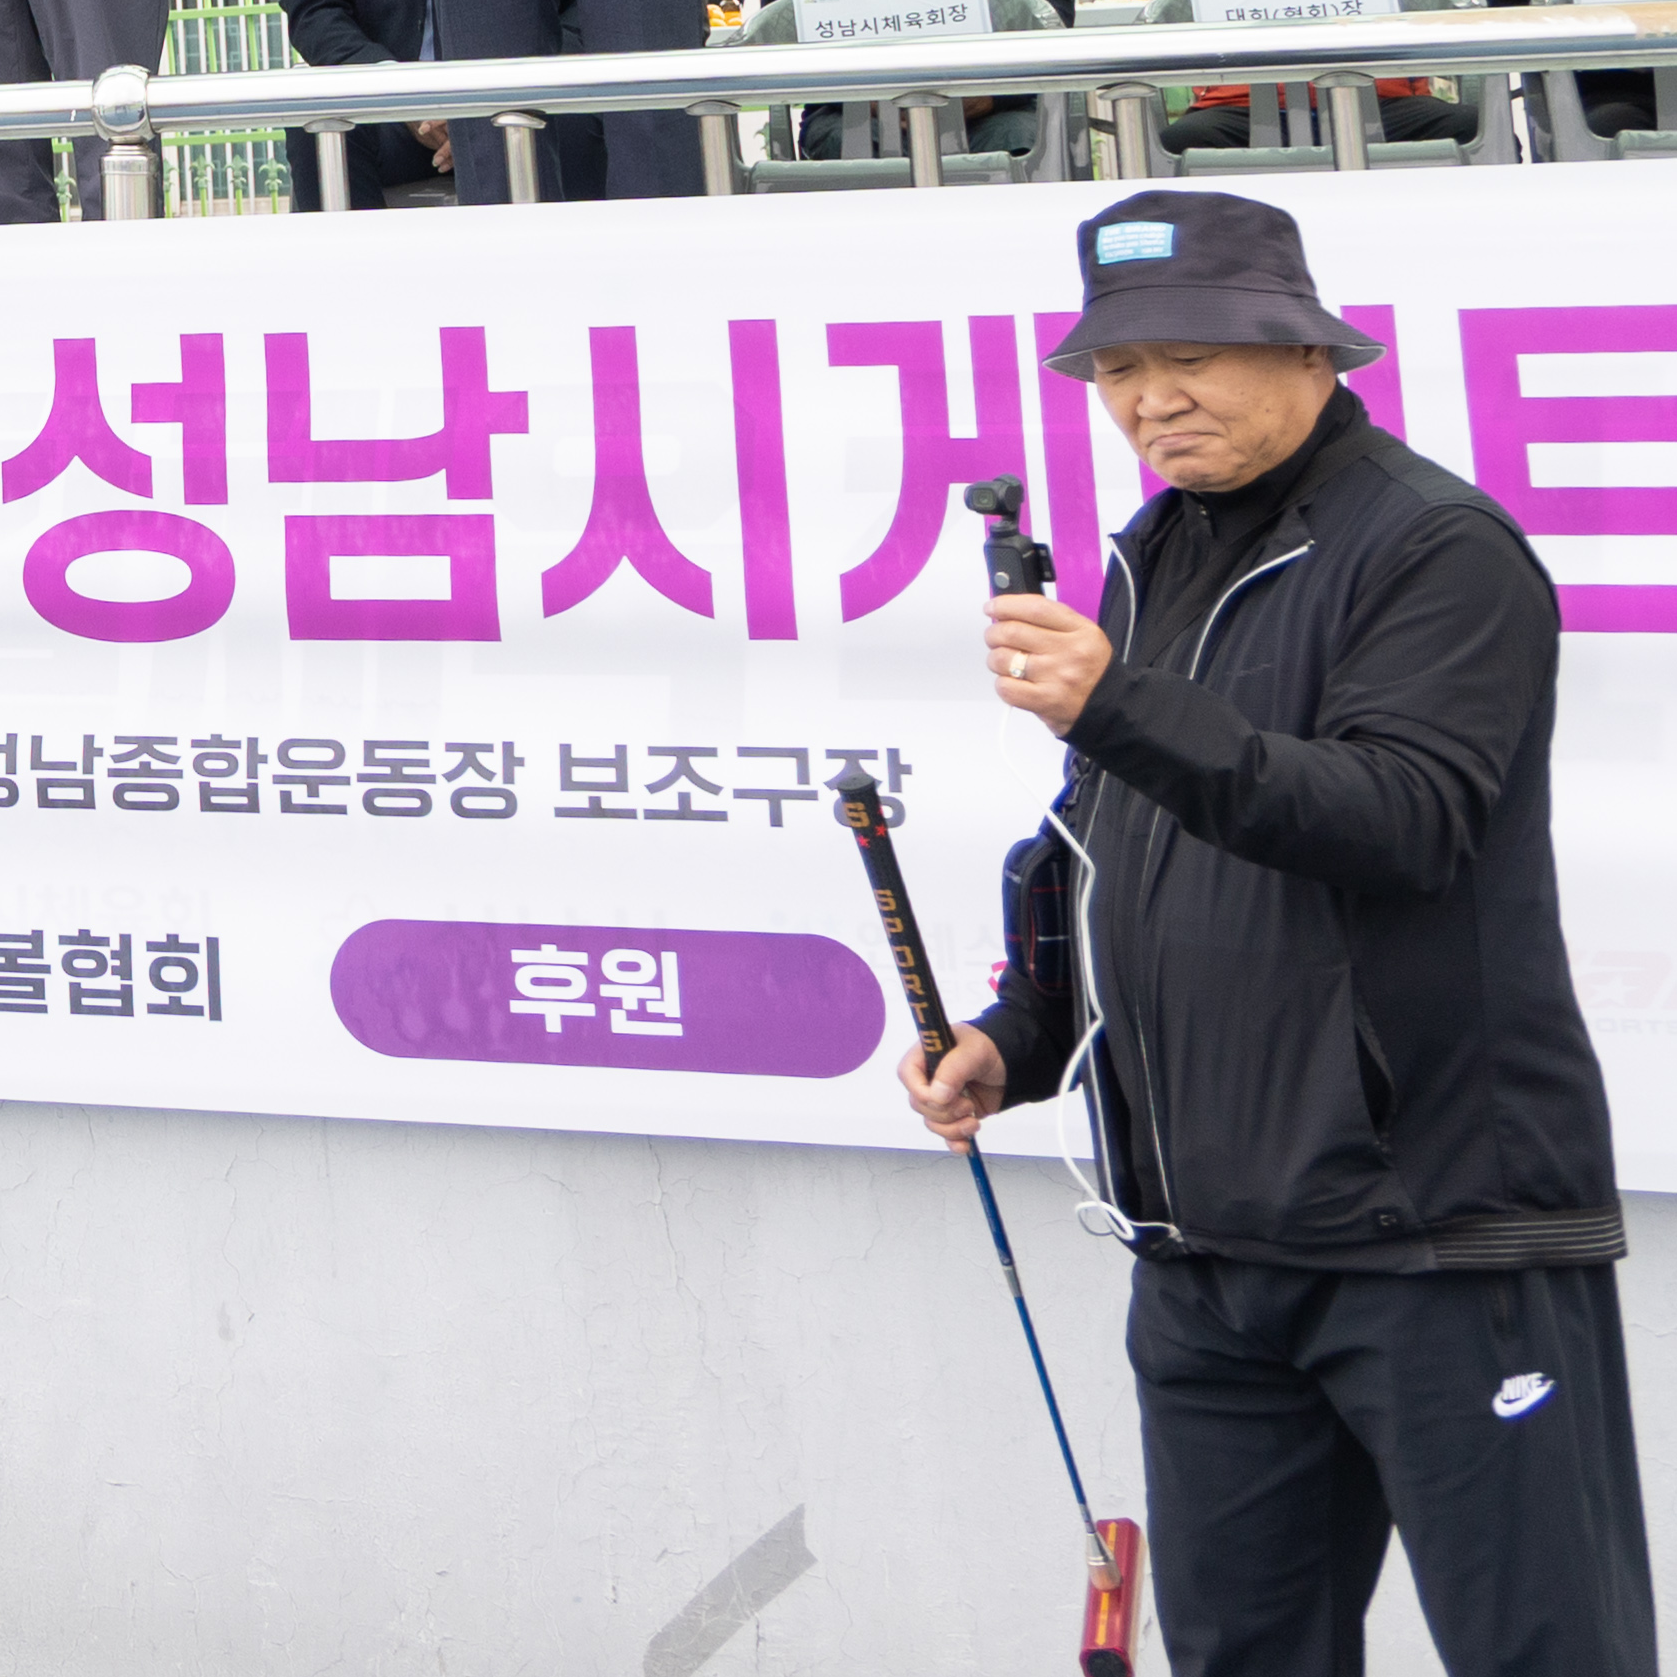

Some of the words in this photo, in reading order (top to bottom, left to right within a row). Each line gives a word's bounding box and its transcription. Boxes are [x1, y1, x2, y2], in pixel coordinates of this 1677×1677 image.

[815, 3, 968, 39] 성남시체육회장
[2, 304, 1677, 643] 성남시게트
[555, 743, 914, 829] 보조구장
[509, 944, 683, 1036] 후원
[873, 888, 944, 1053] SPORTS
[1502, 1372, 1544, 1401] NIKE
